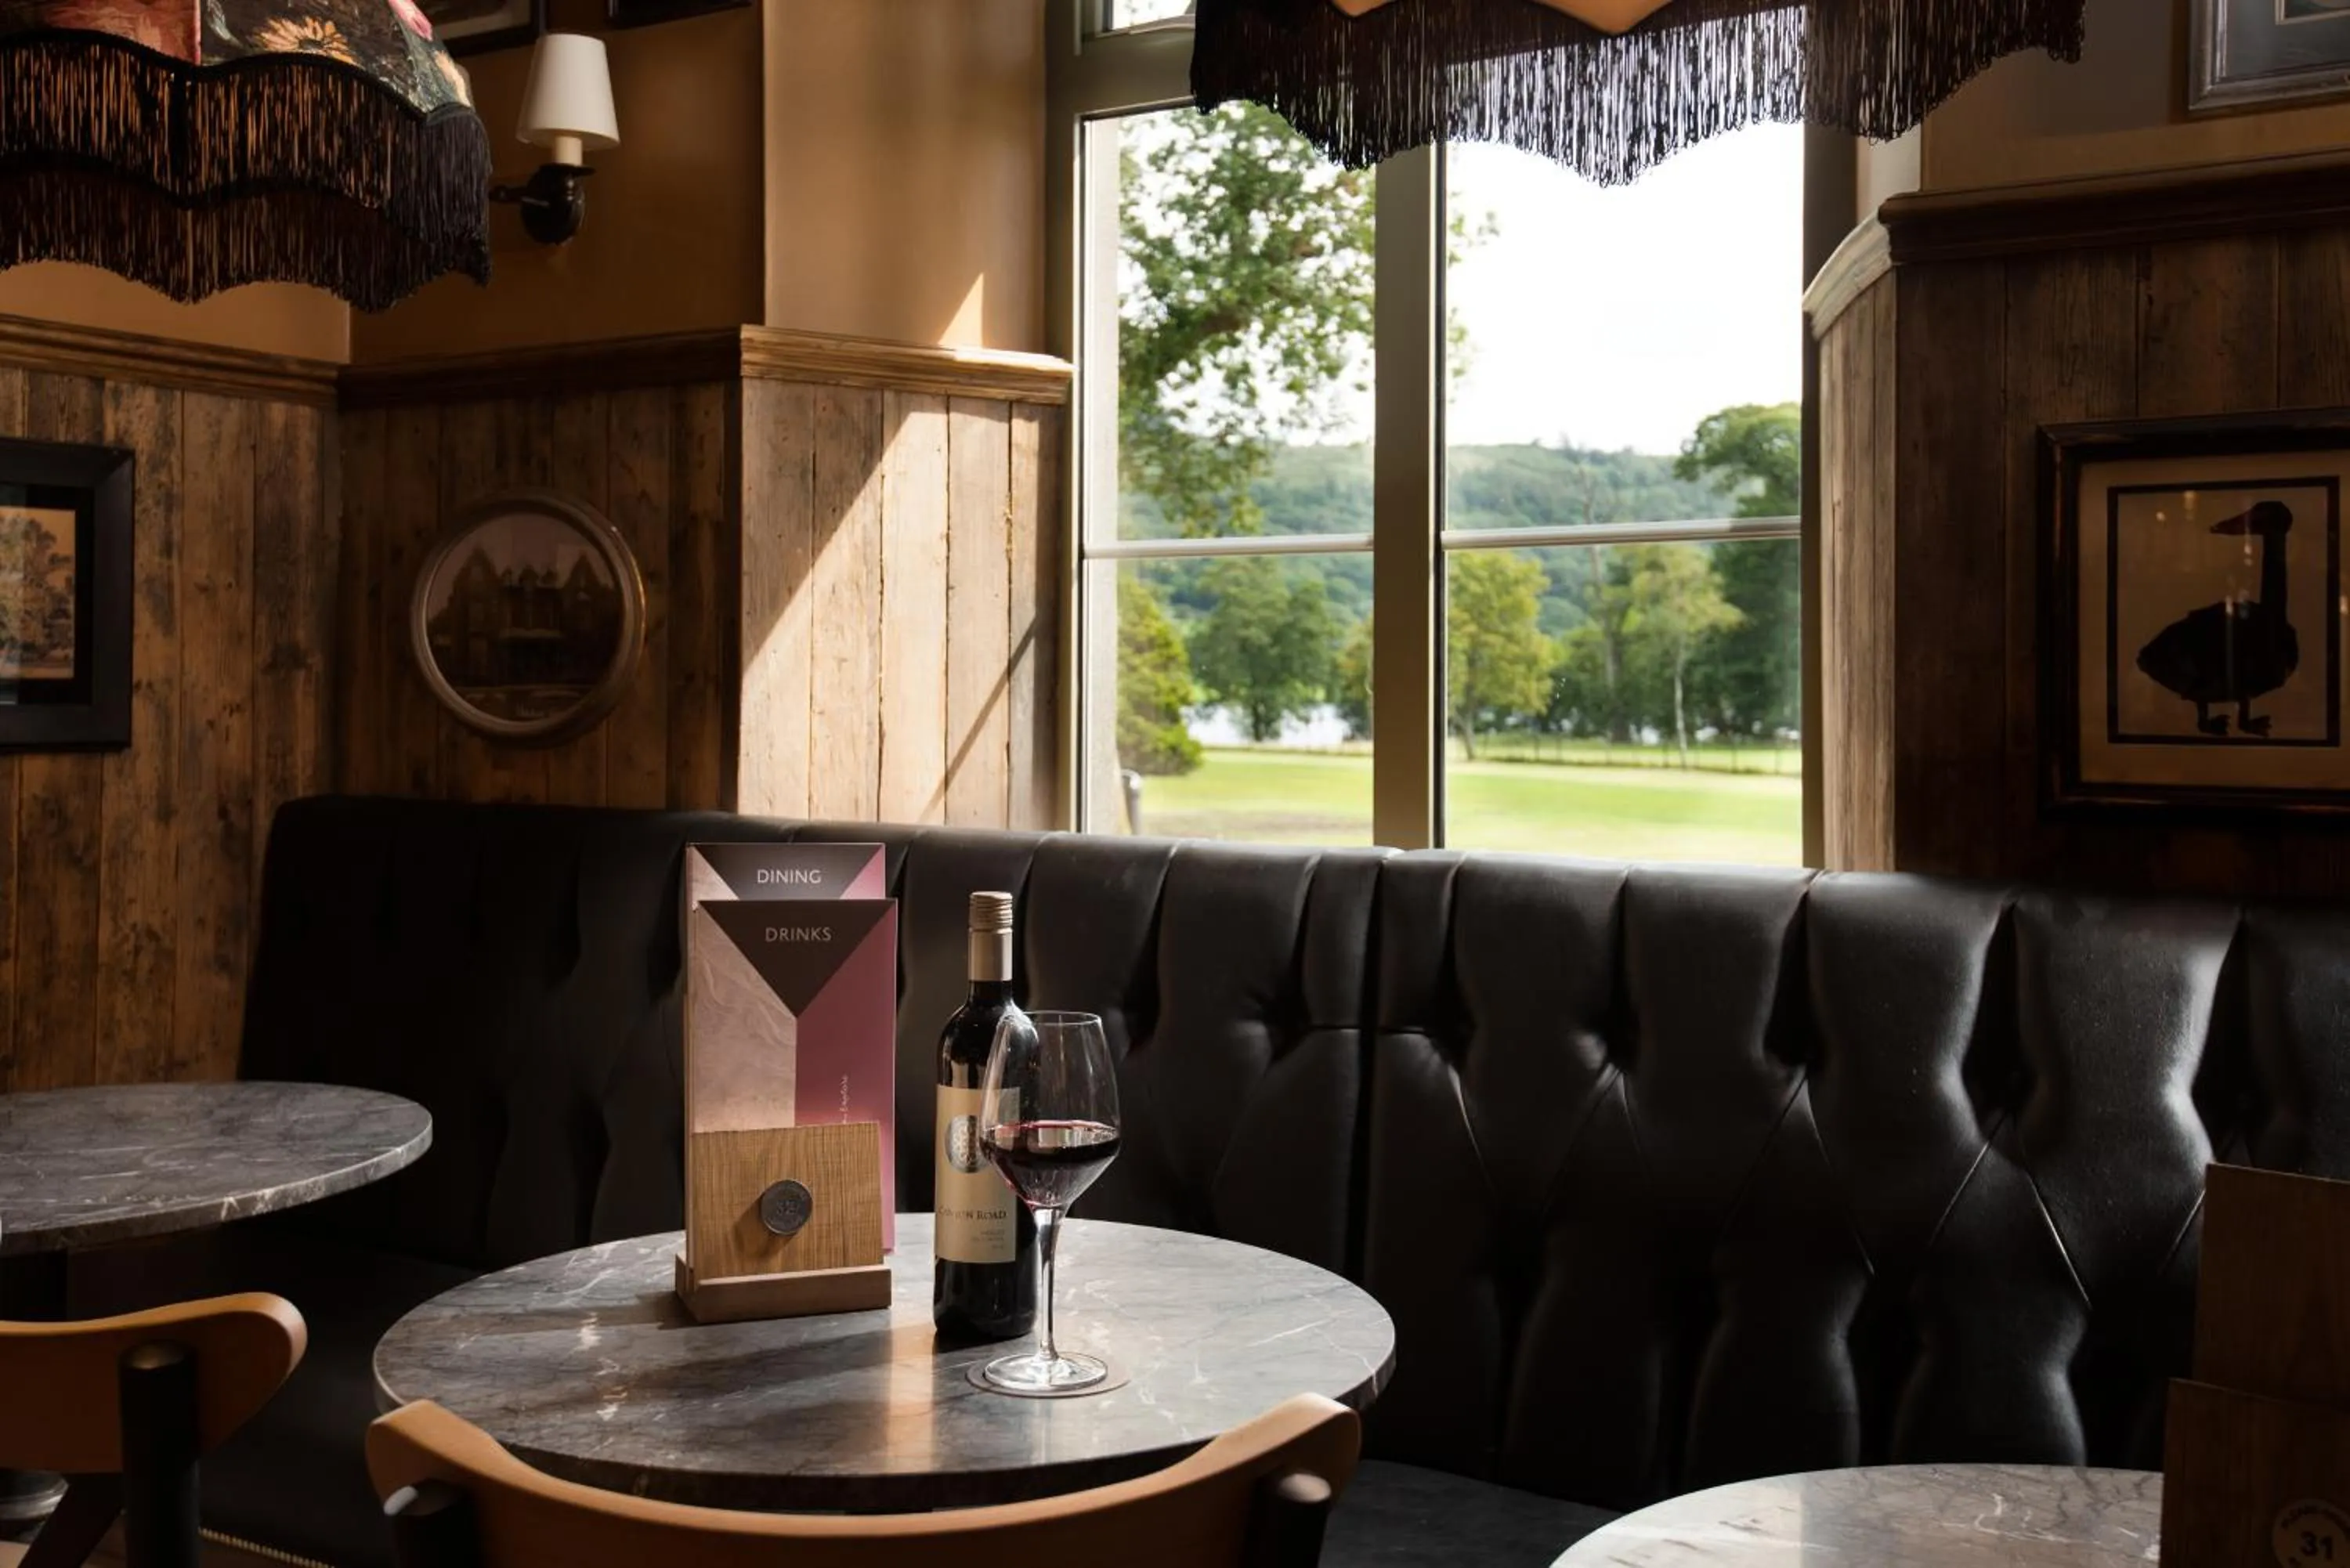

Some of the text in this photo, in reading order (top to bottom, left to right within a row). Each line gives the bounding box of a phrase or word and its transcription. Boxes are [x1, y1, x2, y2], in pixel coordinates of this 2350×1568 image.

[757, 869, 822, 883] DINING
[765, 927, 832, 941] DRINKS
[938, 1205, 1007, 1220] CAN ROAD
[2301, 1531, 2333, 1560] 31
